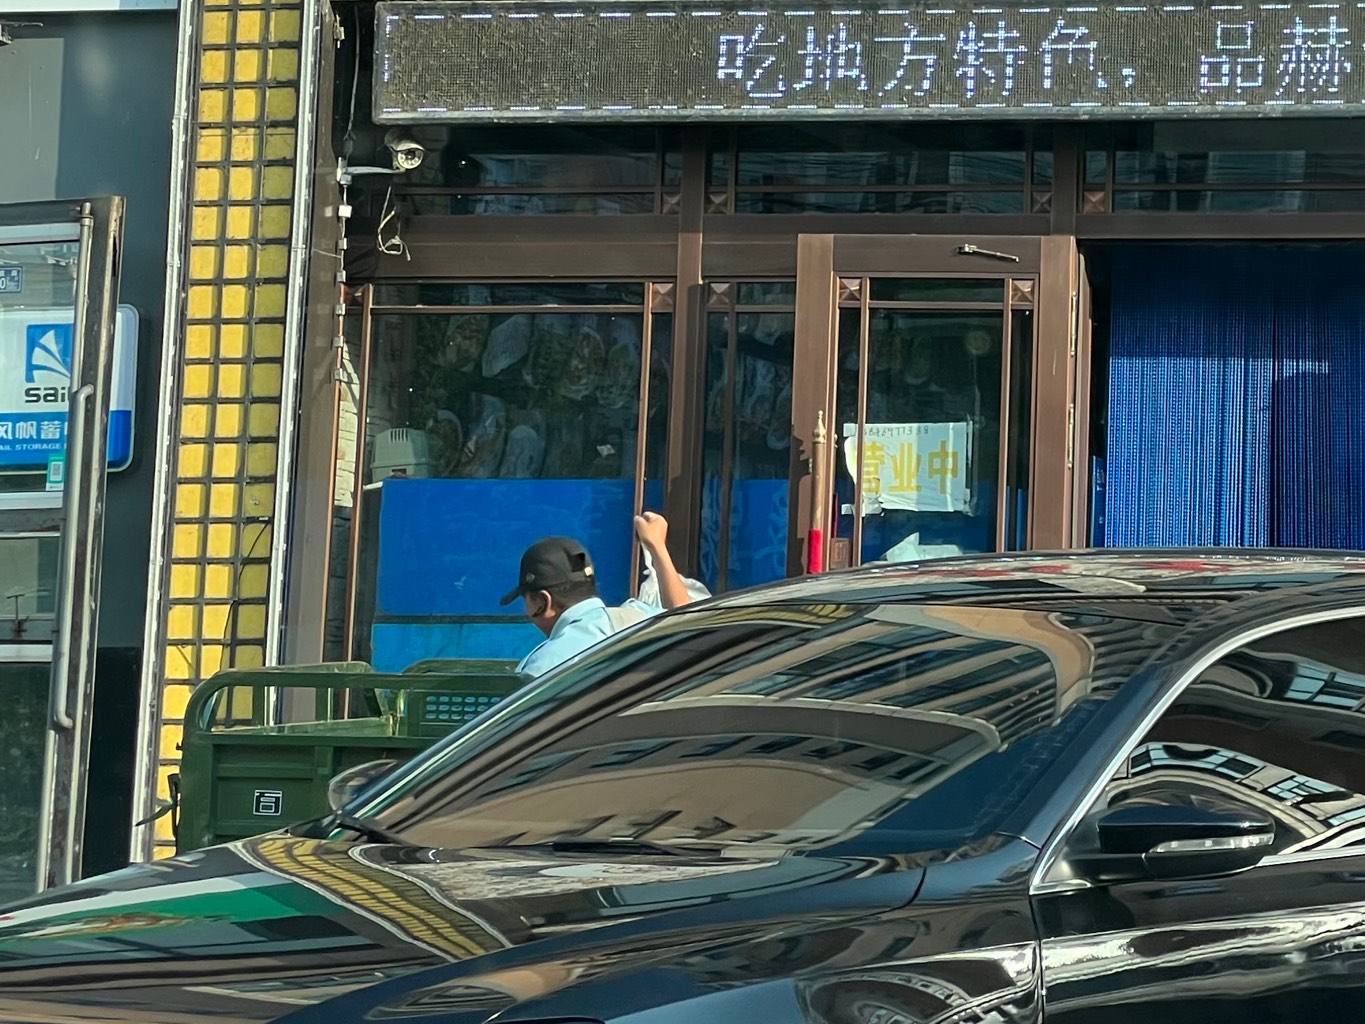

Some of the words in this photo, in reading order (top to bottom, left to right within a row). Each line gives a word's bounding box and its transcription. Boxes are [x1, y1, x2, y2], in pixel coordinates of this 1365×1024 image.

[24, 386, 70, 404] sai
[0, 420, 68, 440] 风帆蓄
[15, 442, 62, 451] STORAGE
[863, 440, 959, 495] 营业中
